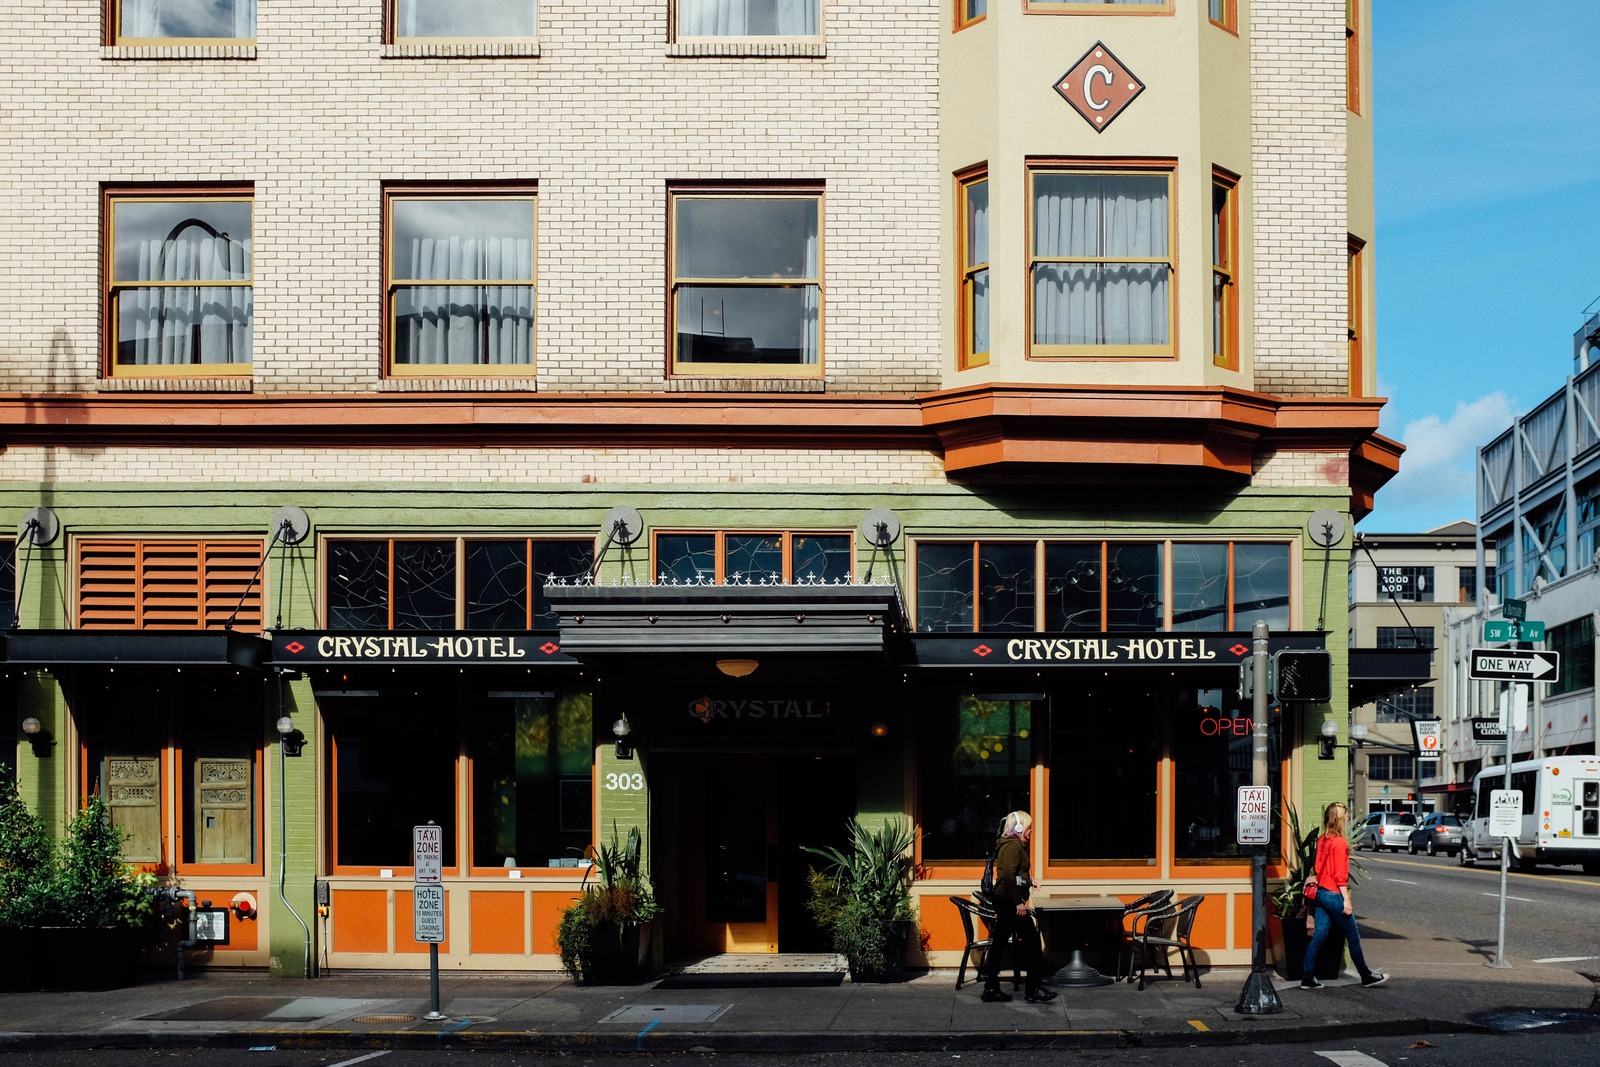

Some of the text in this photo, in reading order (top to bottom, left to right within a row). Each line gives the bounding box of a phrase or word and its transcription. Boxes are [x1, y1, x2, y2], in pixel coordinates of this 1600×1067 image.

[1083, 64, 1114, 110] C
[1490, 629, 1501, 638] SW
[318, 636, 526, 658] CRYSTAL HOTEL
[1007, 639, 1217, 660] CRYSTAL HOTEL
[1480, 658, 1532, 672] ONE WAY
[688, 698, 823, 719] CRYSTAL
[1426, 736, 1435, 749] P
[606, 772, 644, 790] 303
[1243, 790, 1265, 801] TAXI
[1241, 802, 1267, 813] ZONE
[418, 830, 437, 841] TAXI
[416, 842, 439, 853] ZONE
[416, 890, 441, 900] HOTEL
[418, 900, 439, 910] ZONE
